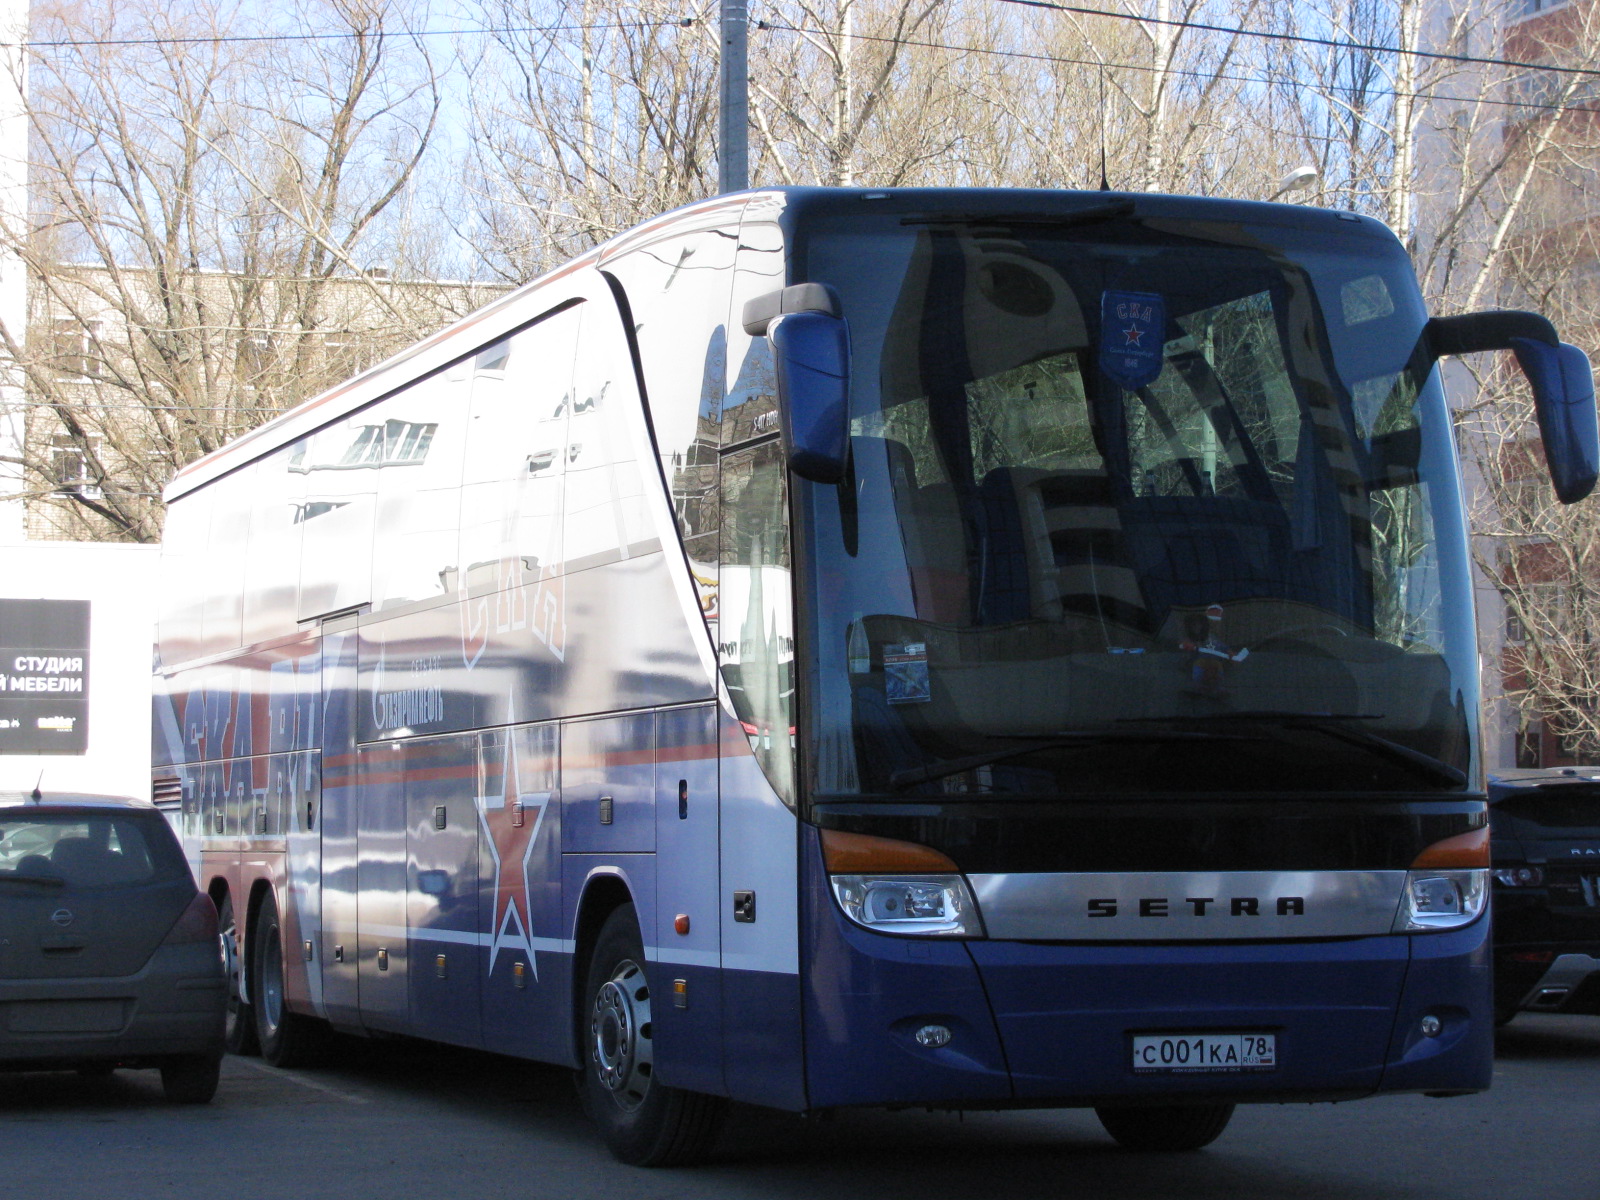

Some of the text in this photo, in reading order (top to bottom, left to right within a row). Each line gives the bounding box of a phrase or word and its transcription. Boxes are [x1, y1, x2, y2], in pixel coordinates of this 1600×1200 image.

[15, 656, 83, 674] СТУДИЯ
[10, 676, 83, 692] МЕБЕЛИ
[385, 685, 443, 728] ГАЗПРОМНЕФТЬ
[1570, 847, 1600, 855] RA
[1087, 896, 1305, 918] SETRA
[1244, 1037, 1267, 1056] 78
[1242, 1056, 1260, 1064] RUS
